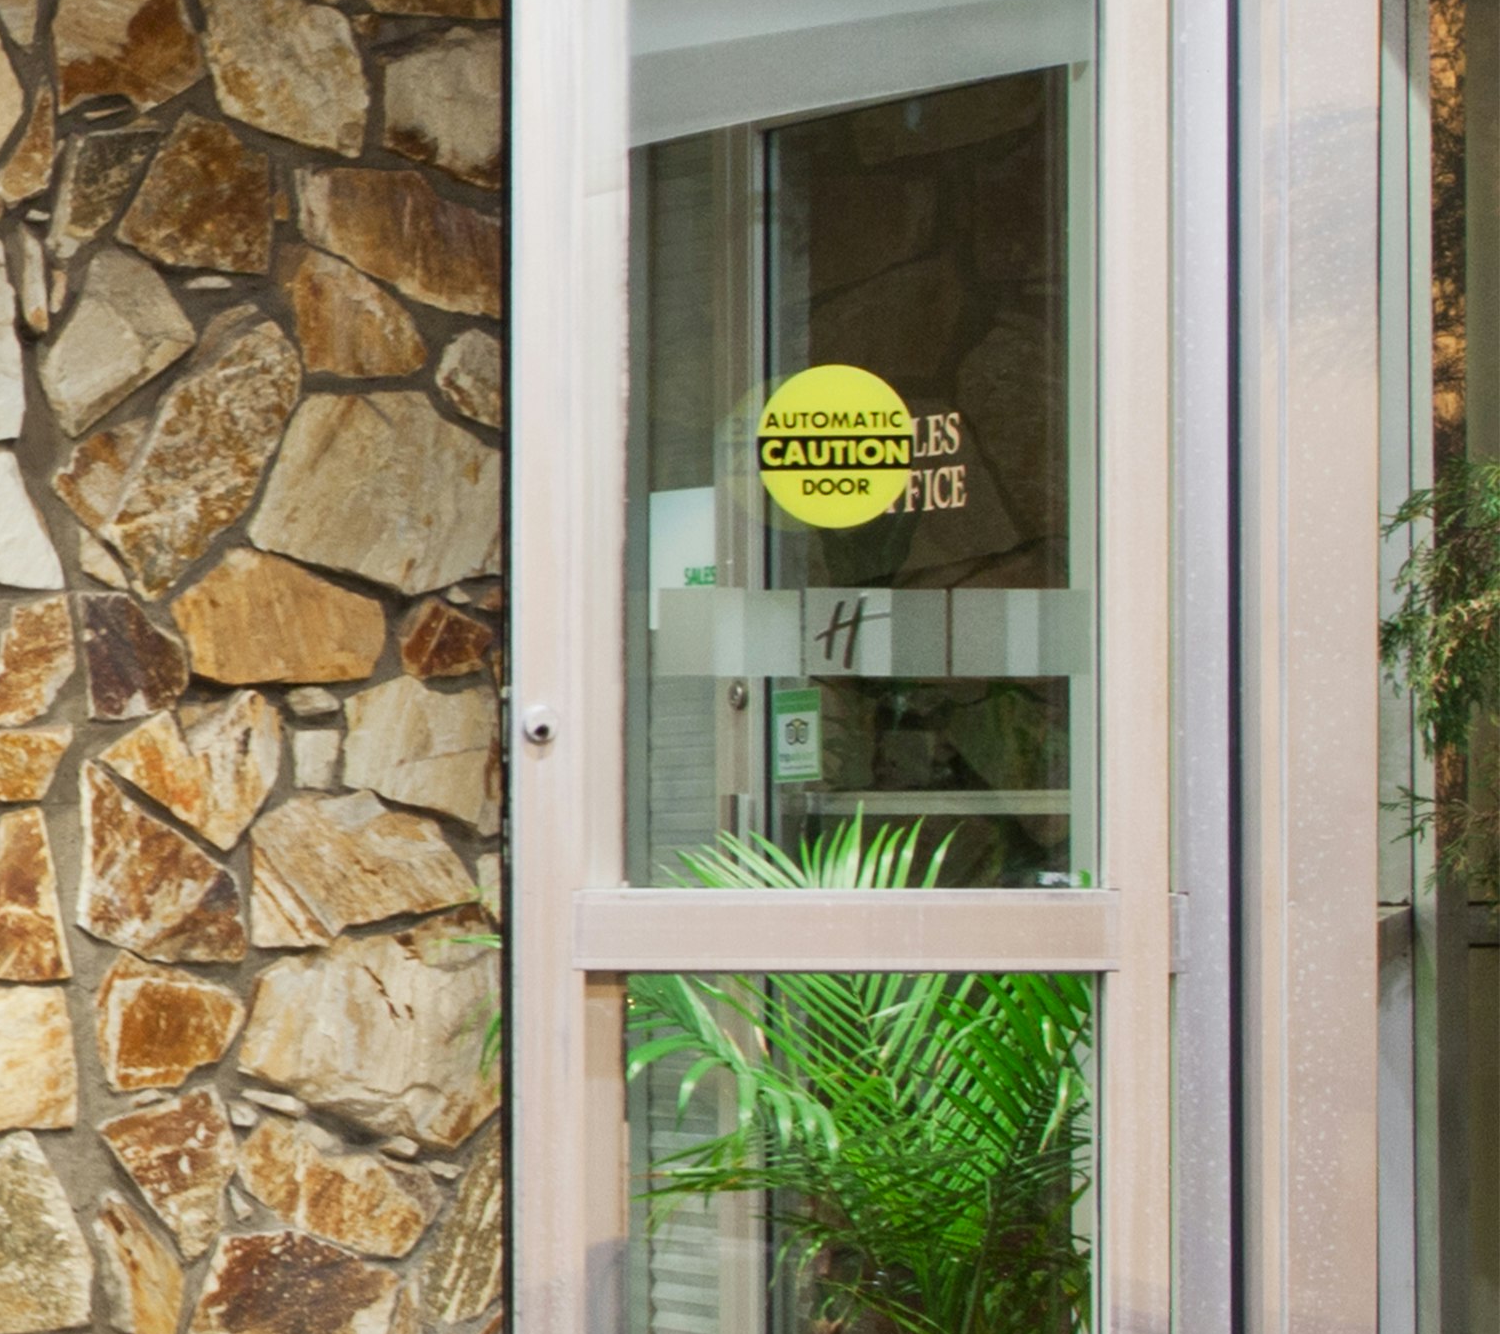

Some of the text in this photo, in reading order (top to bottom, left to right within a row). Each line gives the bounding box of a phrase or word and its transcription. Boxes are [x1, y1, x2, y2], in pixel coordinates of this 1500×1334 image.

[764, 410, 903, 430] AUTOMATIC
[912, 412, 961, 458] LES
[761, 438, 910, 466] CAUTION
[802, 477, 870, 496] DOOR
[885, 465, 967, 514] FICE
[814, 594, 891, 670] H
